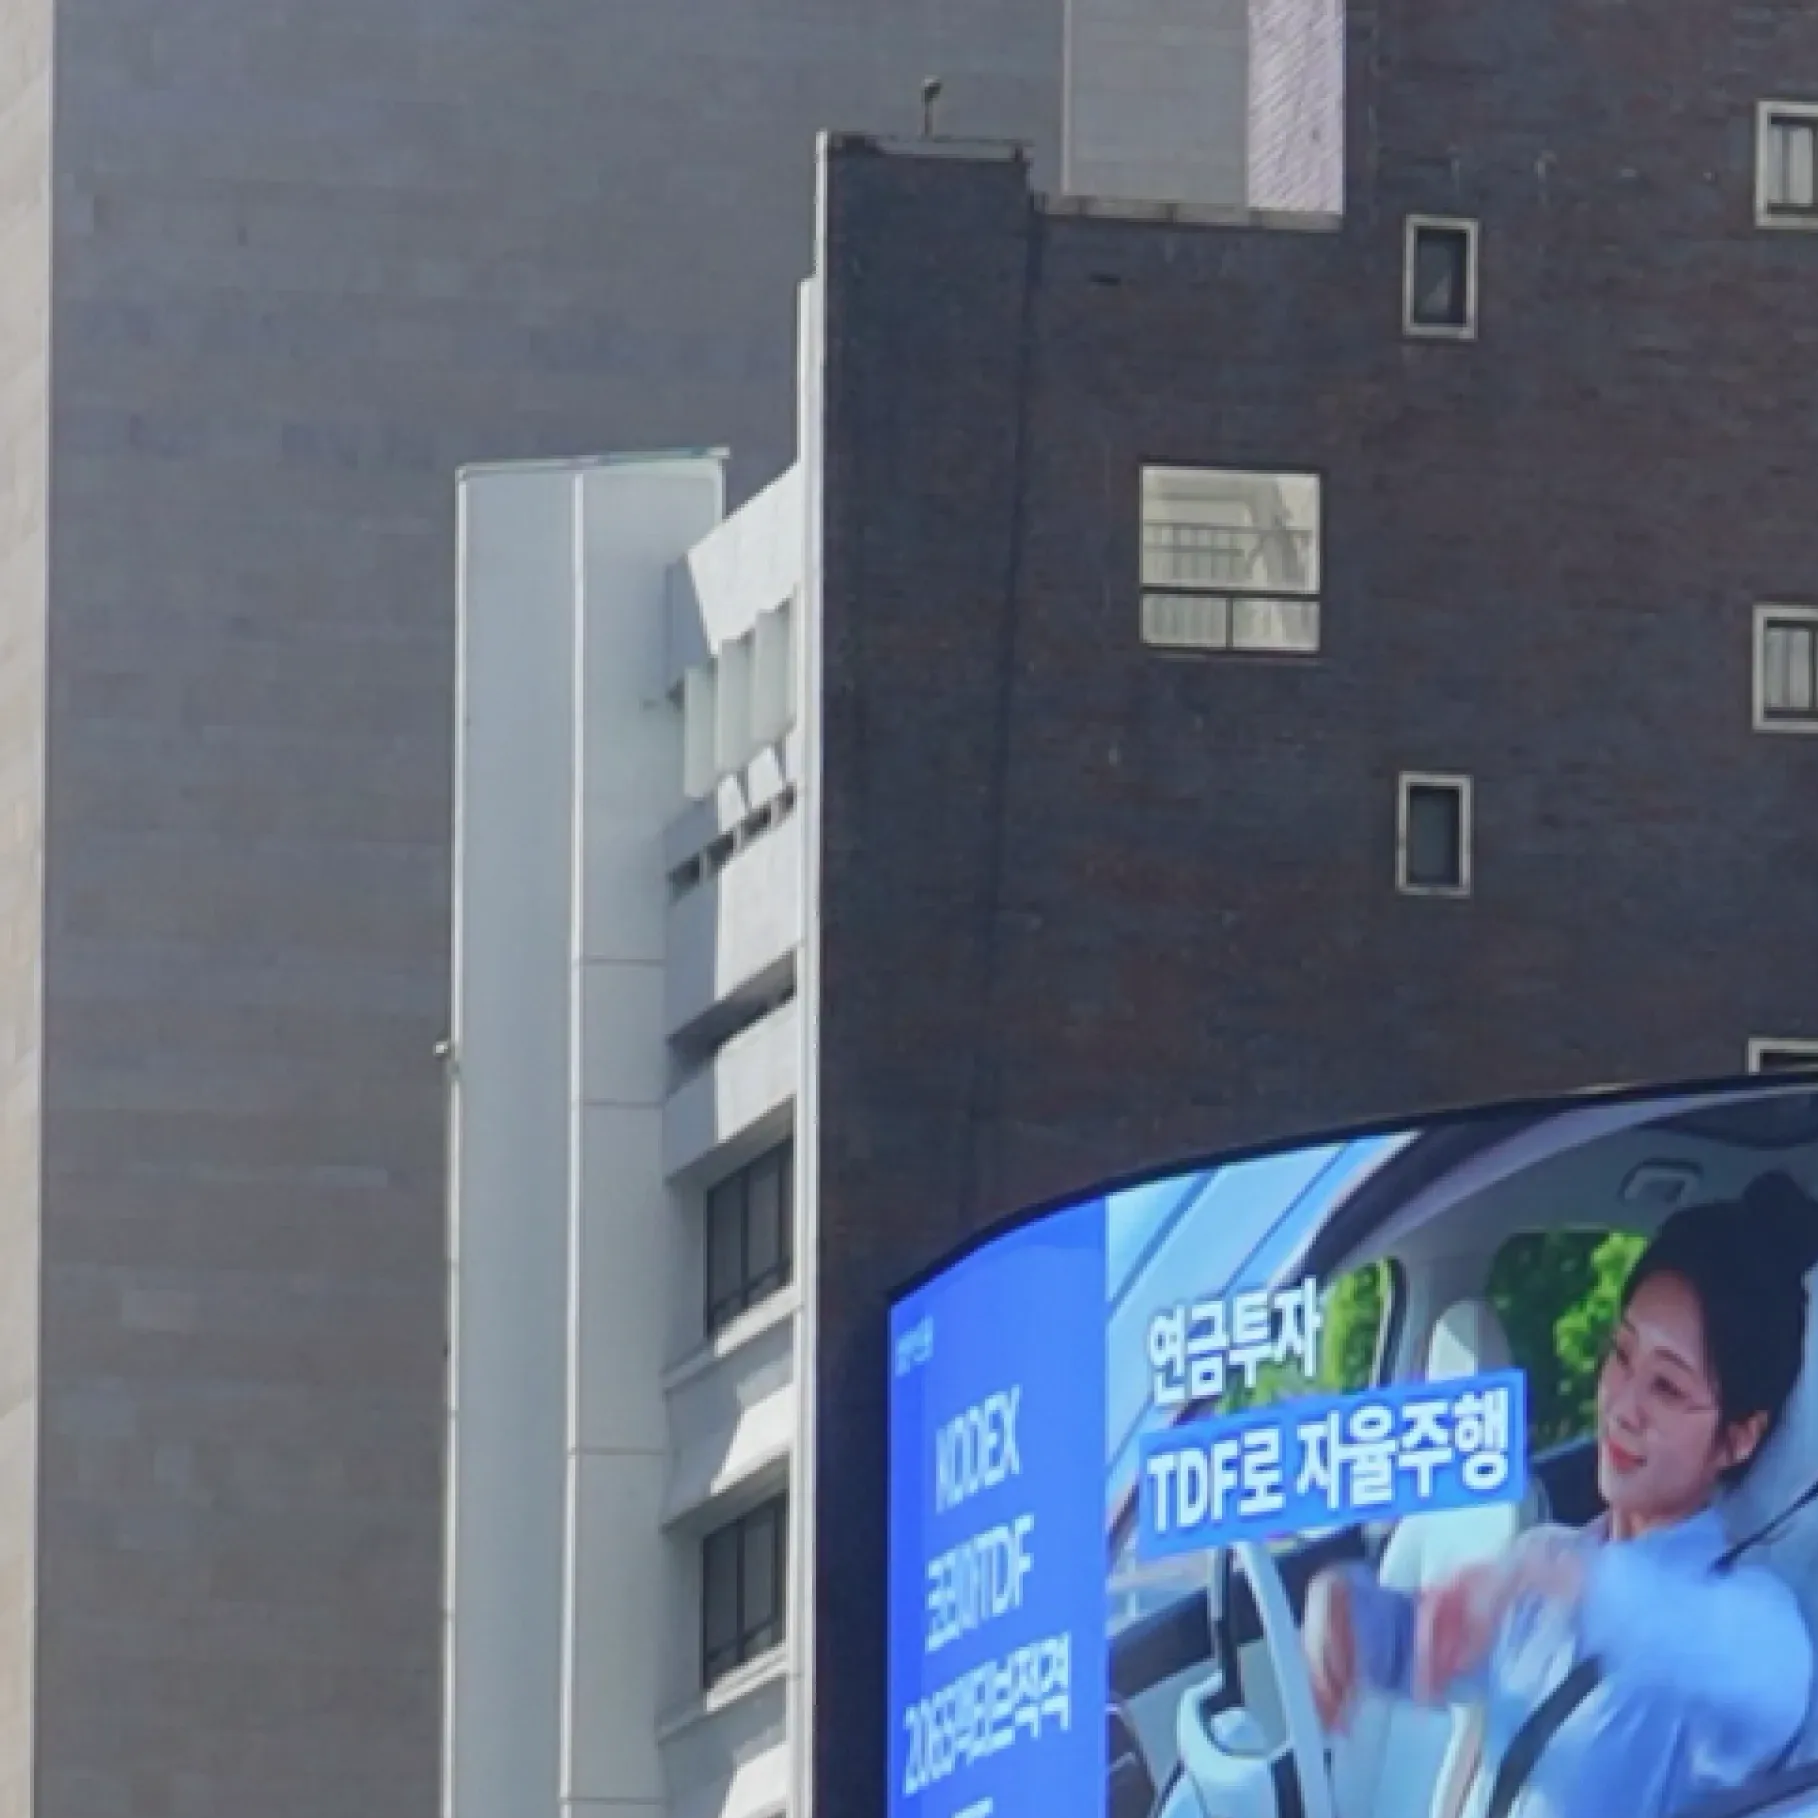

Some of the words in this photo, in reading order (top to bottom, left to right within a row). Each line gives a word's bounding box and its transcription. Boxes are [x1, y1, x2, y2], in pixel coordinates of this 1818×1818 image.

[1148, 1277, 1325, 1405] 연금투자
[1147, 1427, 1285, 1533] TDF로
[1296, 1386, 1509, 1510] 자율주행
